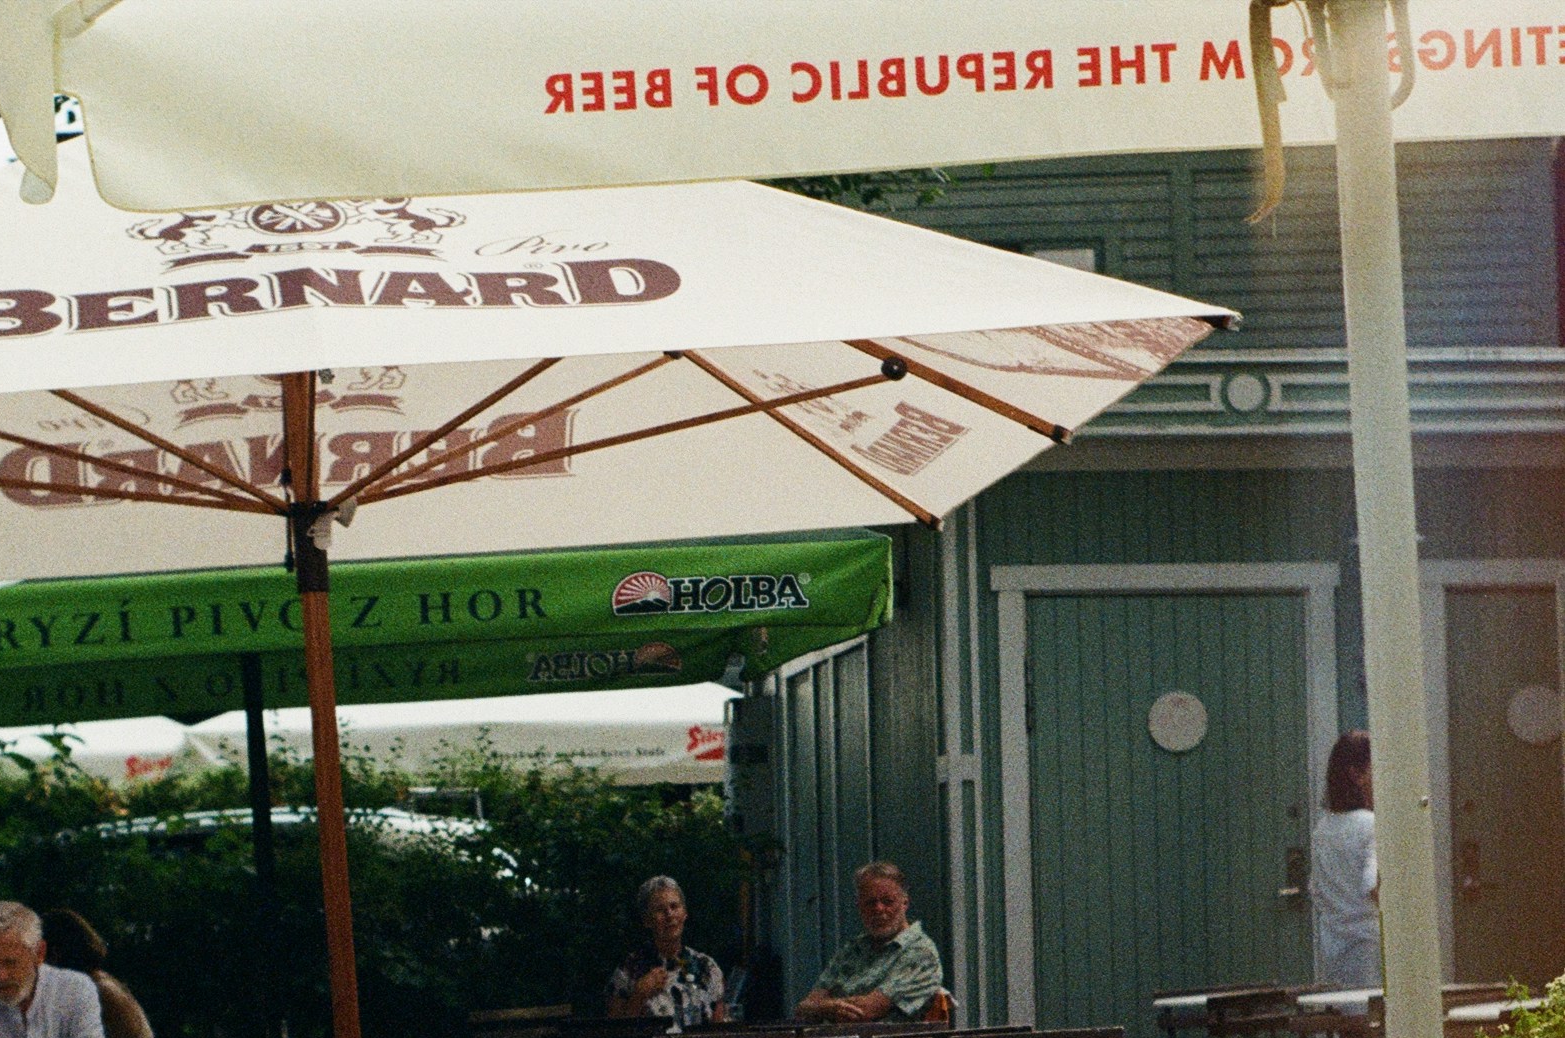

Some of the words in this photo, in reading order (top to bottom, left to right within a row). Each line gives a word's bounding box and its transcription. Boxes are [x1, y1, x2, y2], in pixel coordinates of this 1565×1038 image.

[350, 596, 383, 629] Z
[419, 588, 547, 626] HOR
[668, 573, 809, 613] HOLBA
